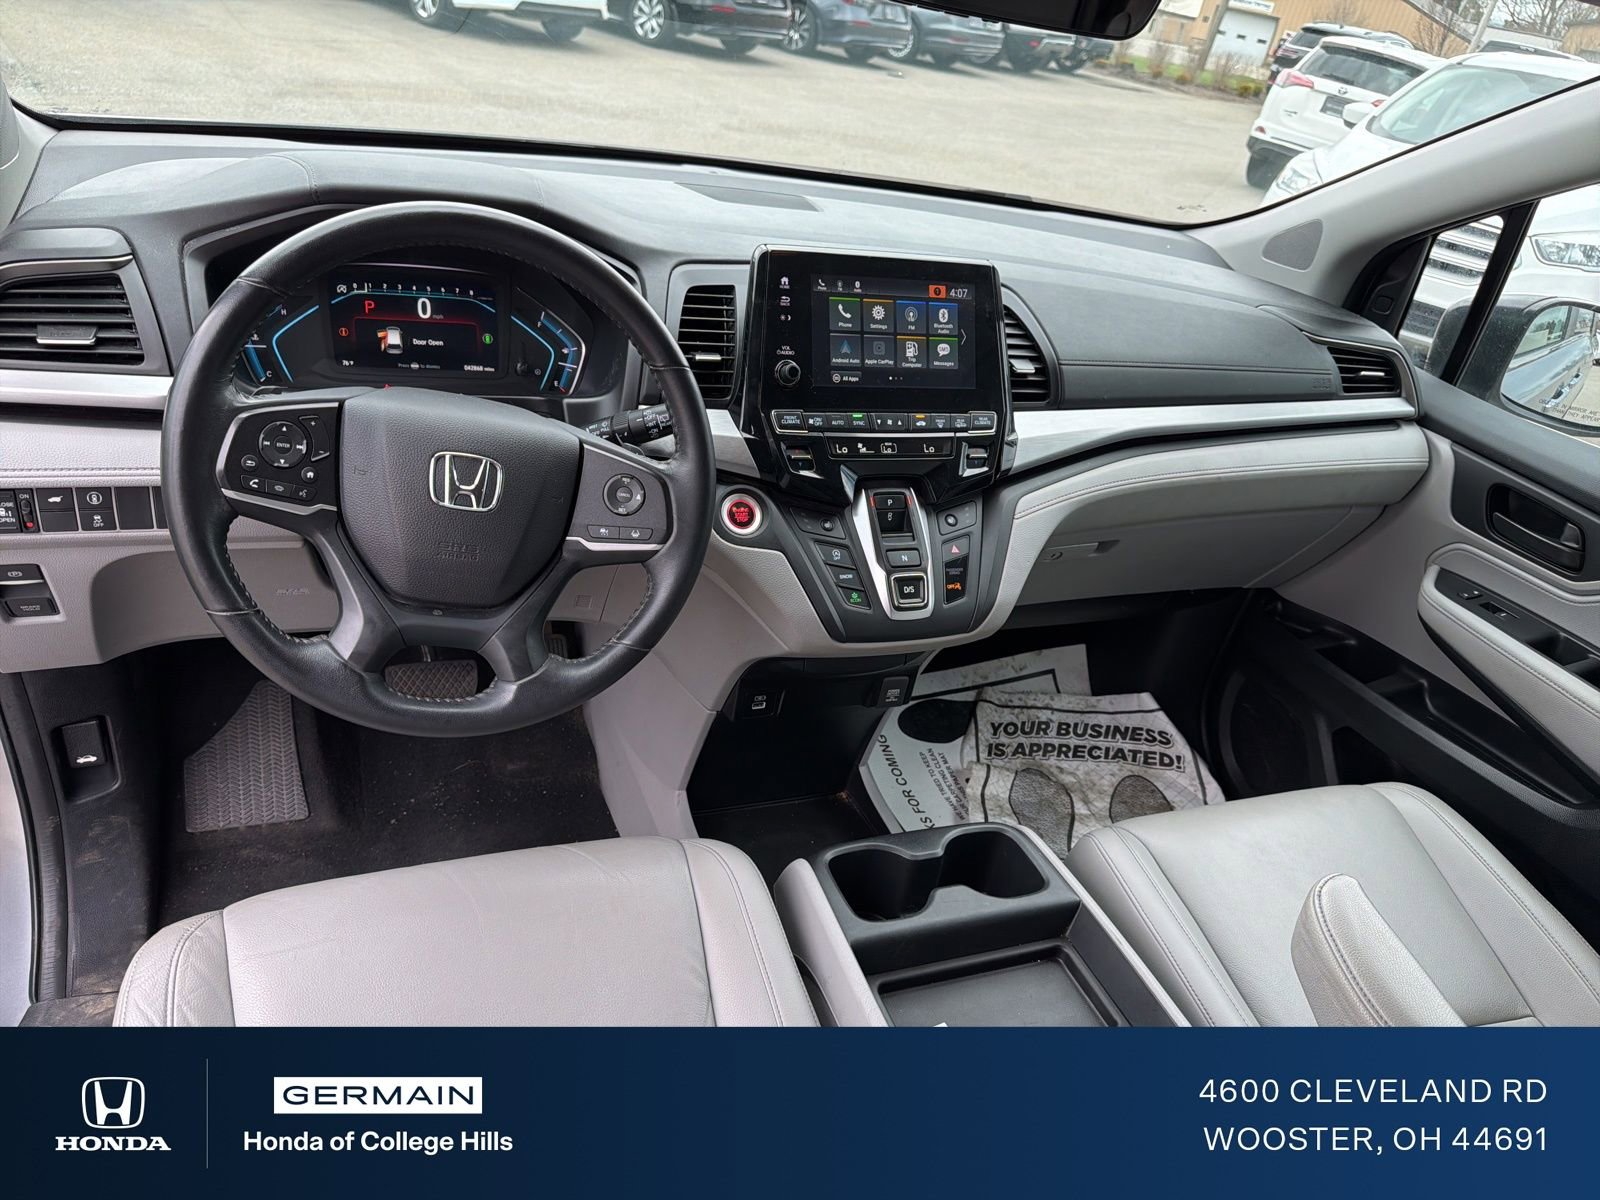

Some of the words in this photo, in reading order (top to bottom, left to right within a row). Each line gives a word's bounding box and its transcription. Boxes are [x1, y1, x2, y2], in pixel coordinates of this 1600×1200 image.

[949, 288, 968, 299] 4:07
[364, 300, 375, 314] P
[417, 297, 432, 319] 0
[870, 323, 888, 331] Settings
[413, 338, 427, 346] Door
[428, 339, 444, 347] Open
[836, 444, 848, 454] Lo
[923, 443, 935, 453] Lo
[901, 554, 908, 562] N
[903, 585, 915, 594] D/S
[990, 720, 1050, 738] YOUR
[1056, 722, 1173, 746] BUSINESS
[878, 734, 908, 786] COMING
[919, 751, 931, 768] KEEP
[926, 748, 941, 769] CLEAN
[987, 743, 1007, 758] IS
[1010, 743, 1183, 770] APPRECIATED!
[928, 768, 936, 778] TO
[933, 778, 946, 796] TRIED
[902, 789, 926, 814] FOR
